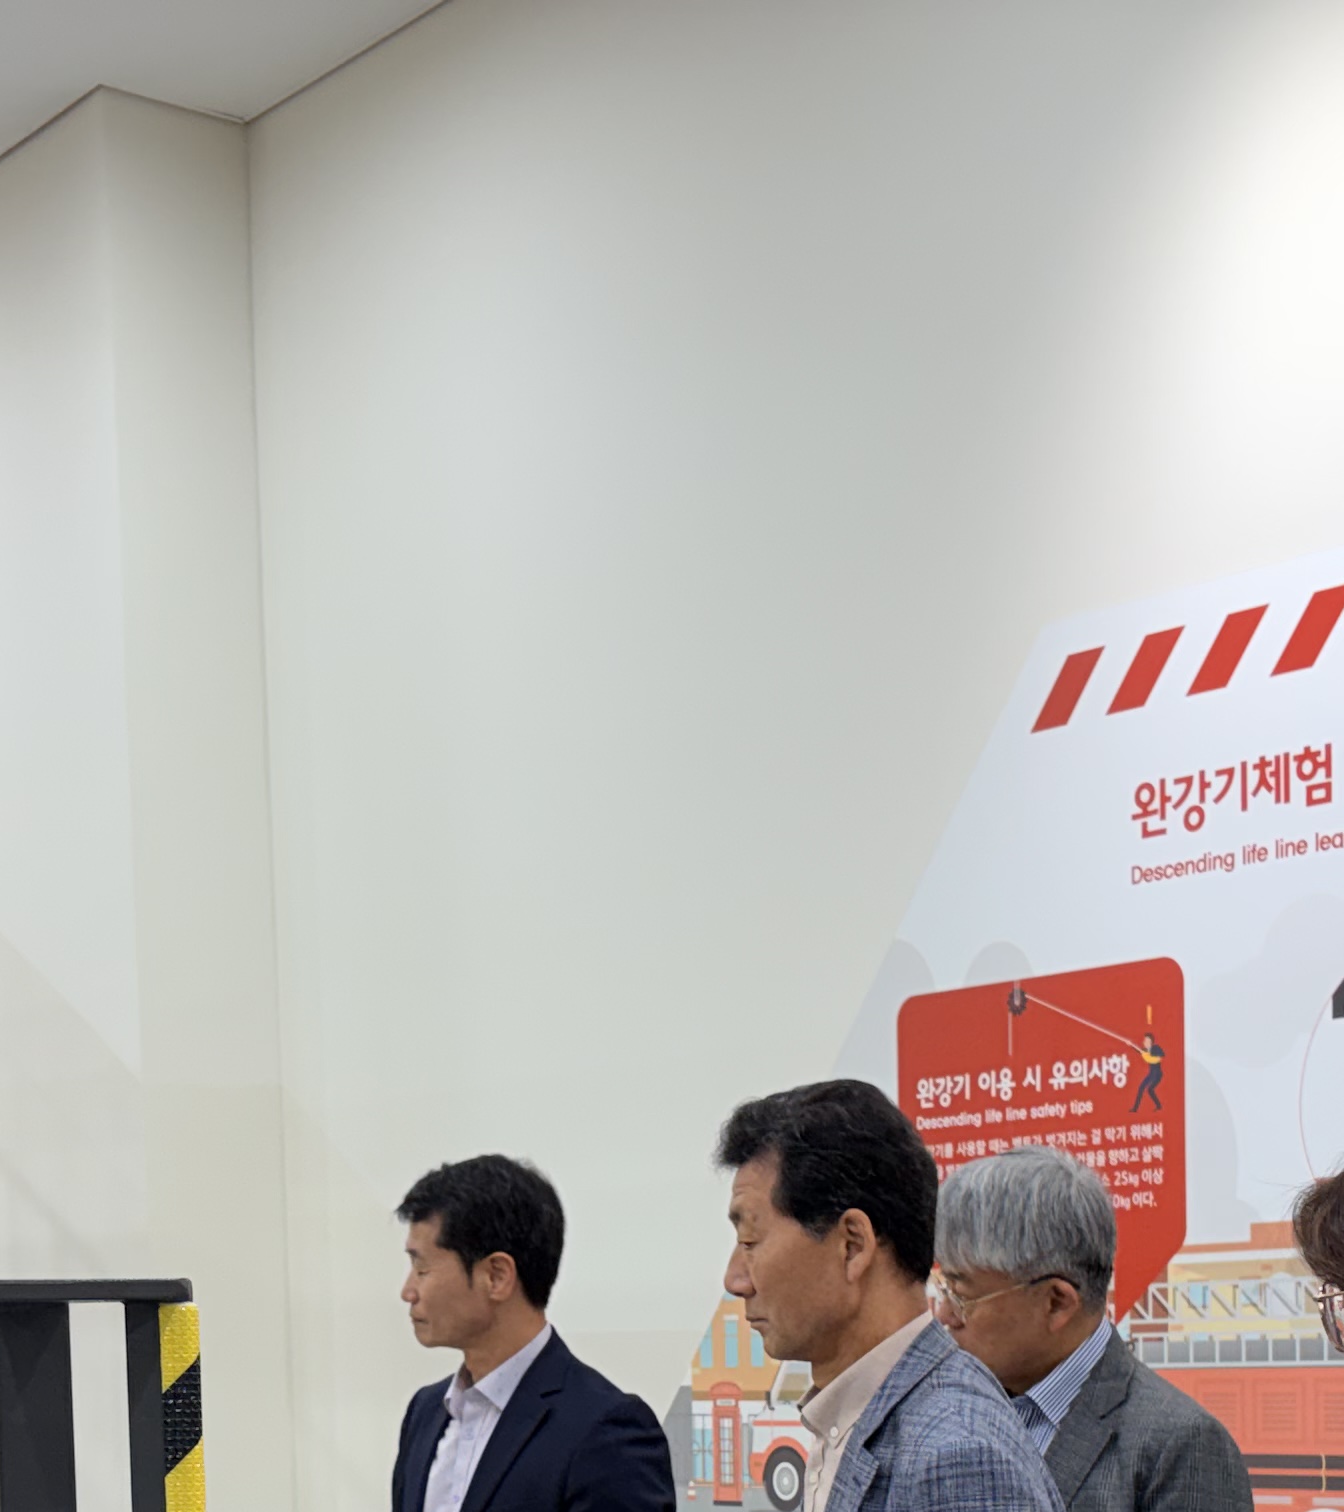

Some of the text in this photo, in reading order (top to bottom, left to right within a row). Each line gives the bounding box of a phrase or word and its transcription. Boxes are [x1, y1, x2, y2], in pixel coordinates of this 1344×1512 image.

[1131, 743, 1333, 839] 완강기체험
[1131, 852, 1235, 884] Descending
[1242, 844, 1269, 864] life
[1274, 838, 1308, 858] line
[916, 1054, 1130, 1108] 완강기 이용 시 유의사항
[916, 1100, 1093, 1130] Descending life line safety tips
[1141, 1168, 1163, 1184] 이상
[1112, 1193, 1131, 1211] 0kg
